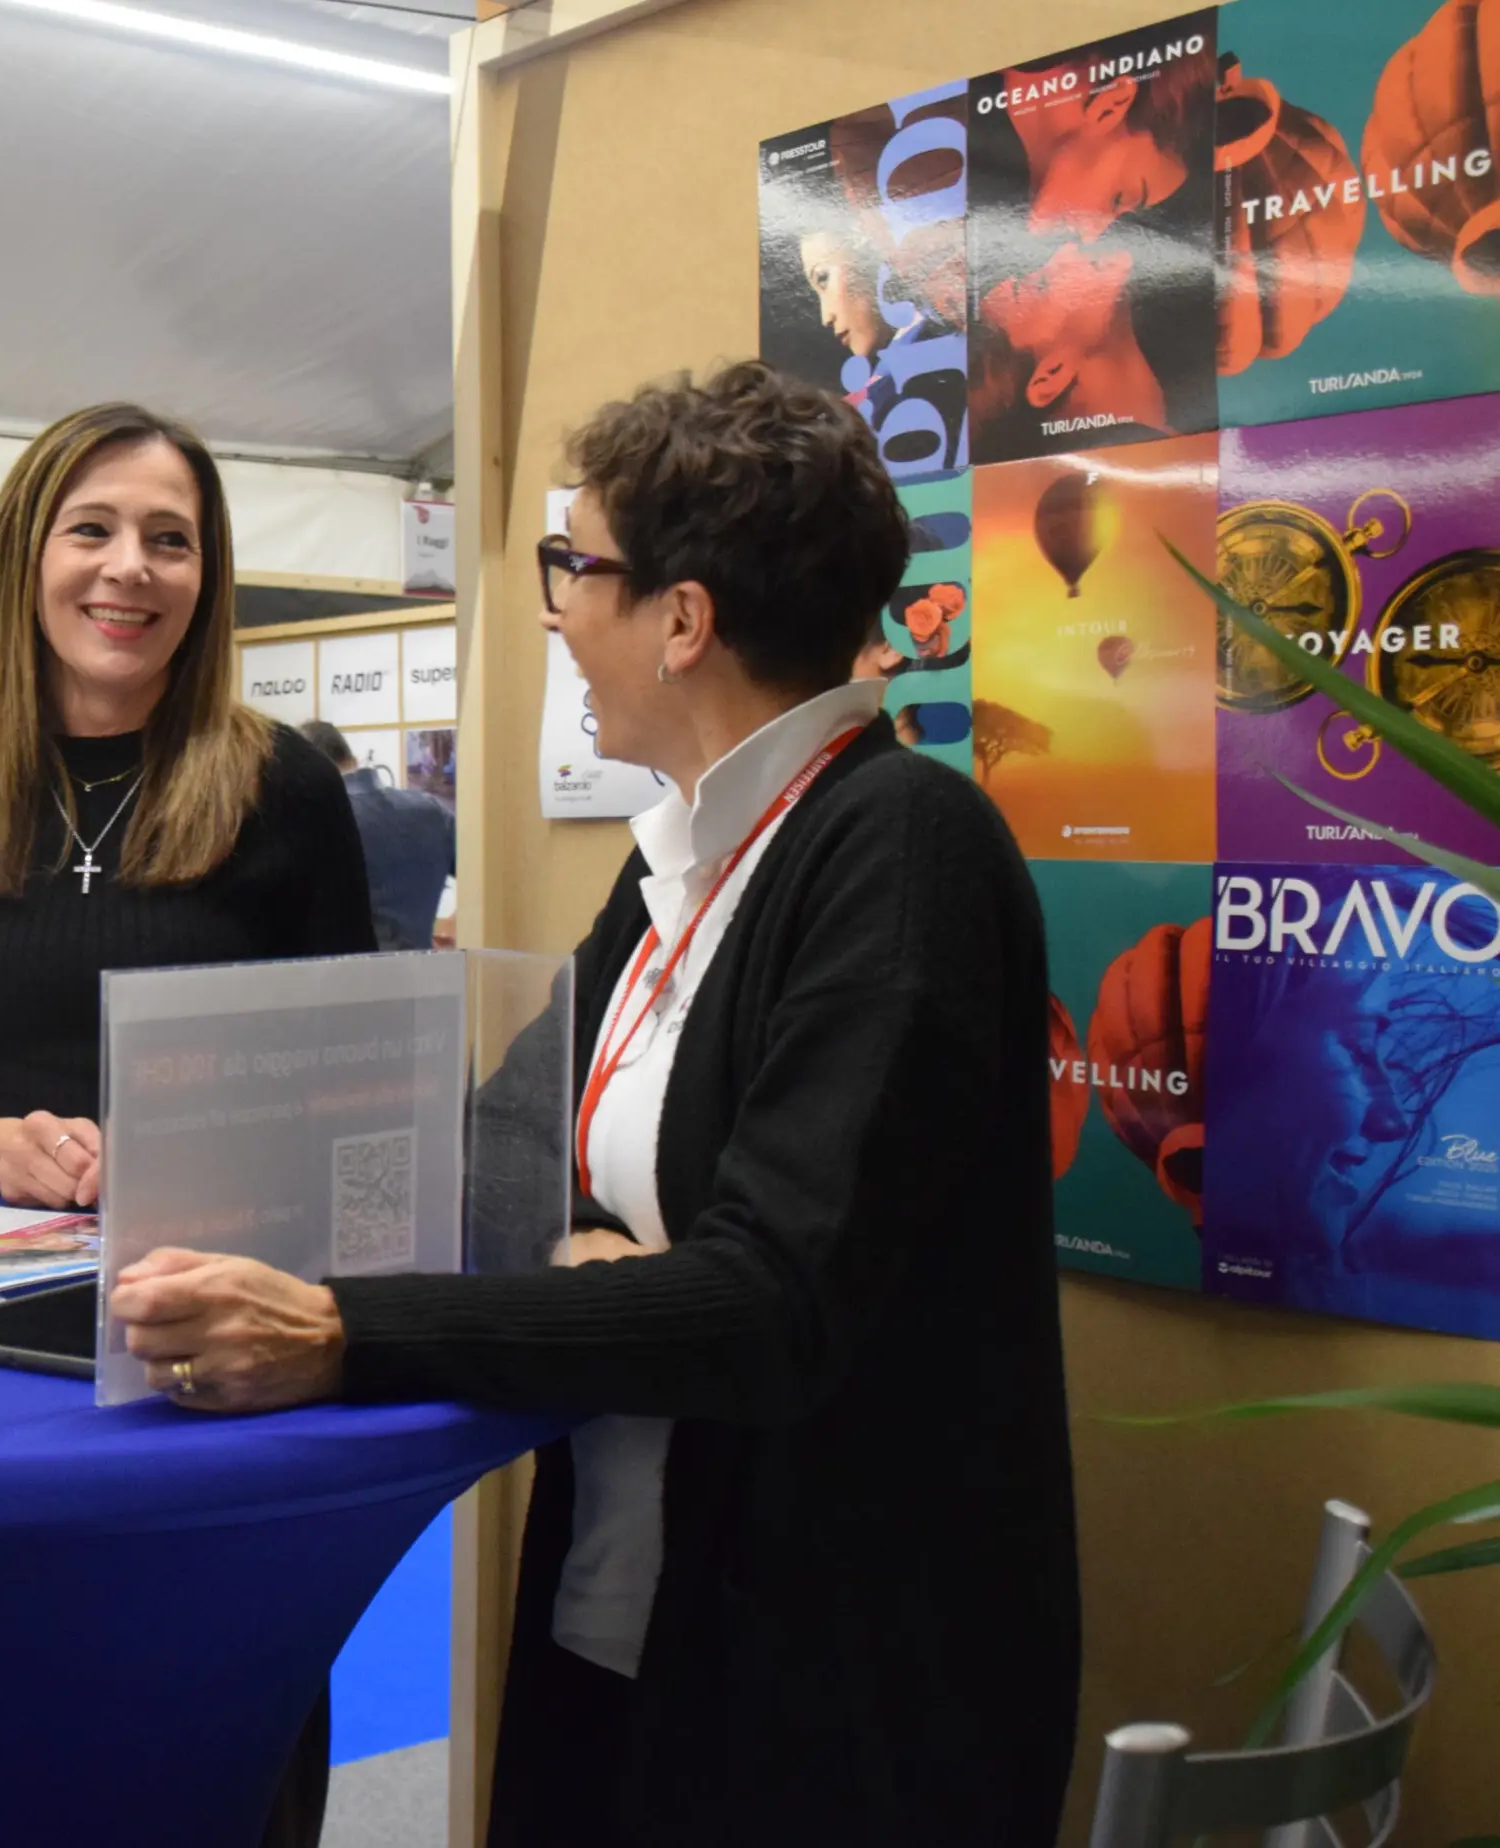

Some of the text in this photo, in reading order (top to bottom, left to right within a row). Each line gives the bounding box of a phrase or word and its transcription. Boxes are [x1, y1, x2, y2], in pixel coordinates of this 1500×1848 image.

[977, 34, 1204, 115] OCEANO INDIANO
[1241, 149, 1492, 225] TRAVELLING
[1309, 367, 1400, 394] TURISANDA
[1041, 413, 1116, 436] TURISANDA
[1286, 623, 1461, 656] OYAGER
[331, 671, 382, 694] RADIO
[1305, 825, 1394, 840] TURISAN
[1216, 876, 1500, 963] BRAVO
[1215, 953, 1500, 978] IL TUO VILLAGGIO ITALIANO
[1048, 1057, 1189, 1096] VELLING
